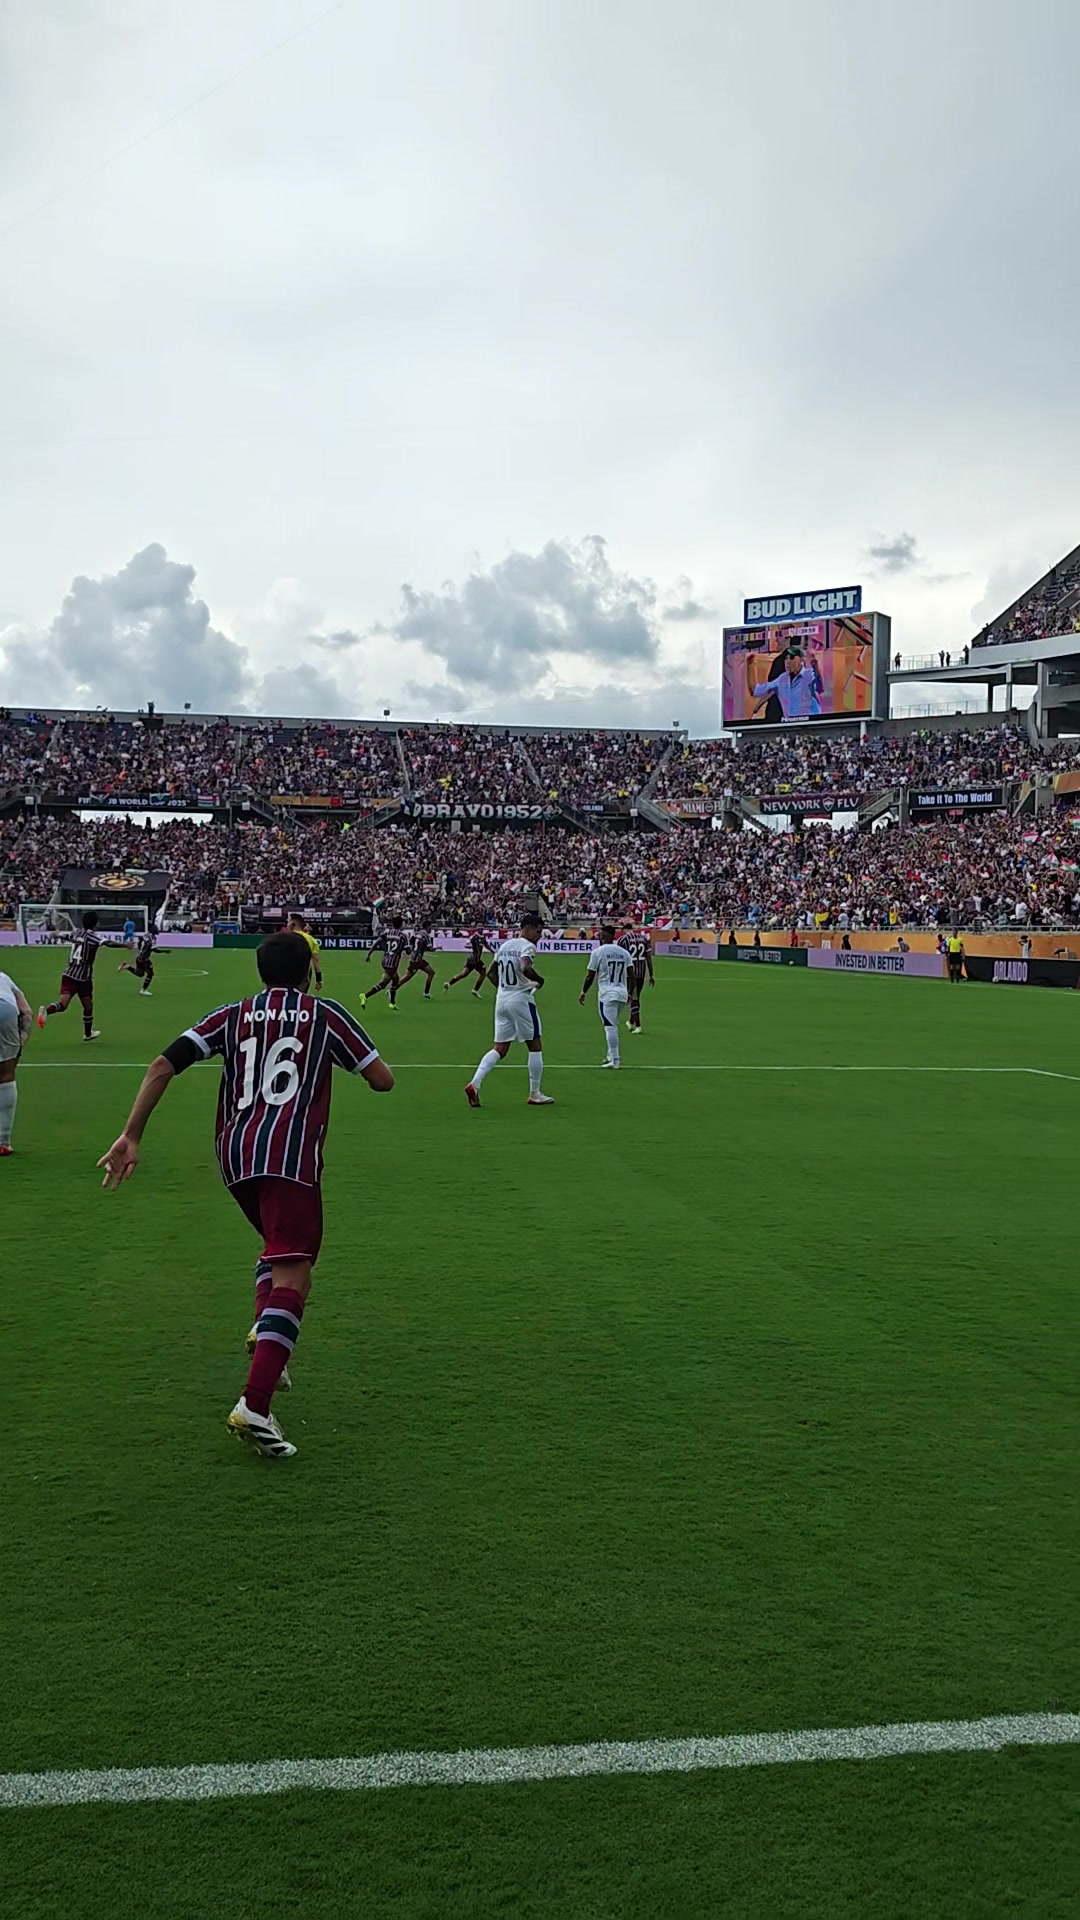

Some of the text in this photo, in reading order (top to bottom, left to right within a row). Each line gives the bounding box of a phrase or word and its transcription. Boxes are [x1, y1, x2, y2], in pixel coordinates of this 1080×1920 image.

[747, 590, 857, 620] BUD LIGHT
[762, 801, 791, 812] NEW
[791, 799, 820, 811] YORK
[918, 791, 993, 805] Take It To The World
[325, 938, 337, 948] IN
[539, 942, 593, 951] IN BETTER
[629, 943, 646, 960] 22
[835, 953, 905, 972] INVESTED IN BETTER
[994, 960, 1028, 982] ORLANDO
[607, 960, 625, 983] 77
[243, 1008, 310, 1024] NONATO
[238, 1036, 304, 1110] 16
